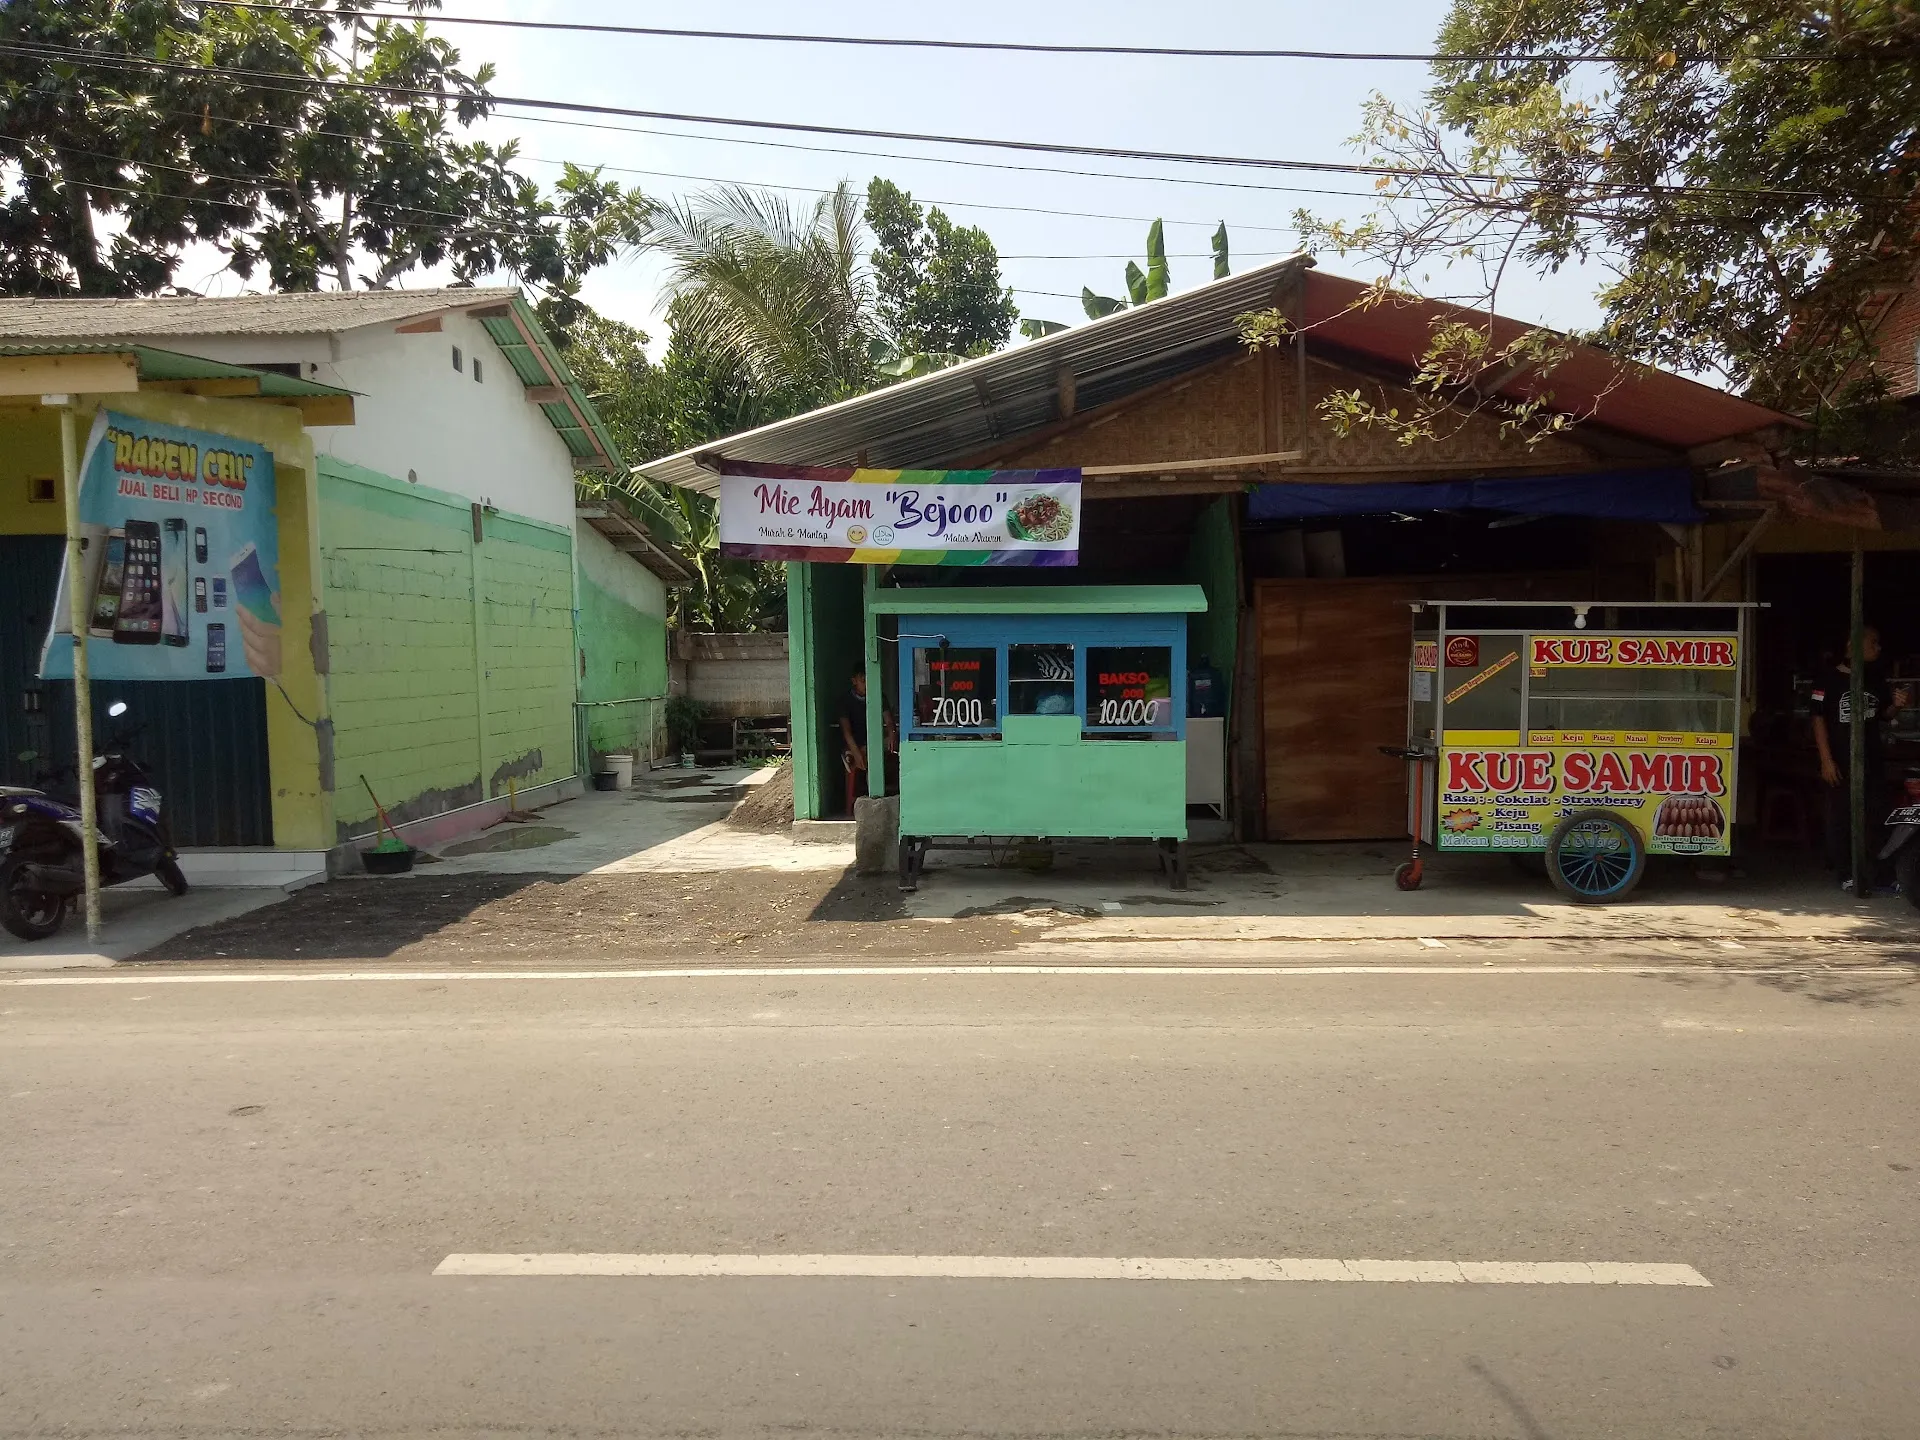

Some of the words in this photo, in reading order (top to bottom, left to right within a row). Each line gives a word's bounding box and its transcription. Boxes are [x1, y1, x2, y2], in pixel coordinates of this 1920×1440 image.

[118, 479, 148, 497] JUAL
[153, 484, 180, 501] BELI
[186, 488, 198, 503] HP
[202, 491, 243, 509] SECOND
[753, 483, 801, 515] Mie
[807, 485, 875, 530] Ayam
[758, 526, 785, 538] Murah
[797, 528, 828, 542] Mantap
[1533, 639, 1613, 664] KUE
[1617, 640, 1735, 667] SAMIR
[951, 661, 980, 671] AYAM
[1098, 672, 1150, 686] BAKSO
[931, 697, 982, 727] 7000
[1098, 698, 1159, 726] 10.000
[1562, 733, 1583, 742] Keju
[1593, 734, 1614, 742] Pisang
[1695, 736, 1717, 745] Kelapa
[1447, 751, 1556, 794] KUE
[1562, 751, 1727, 796] SAMIR
[1562, 795, 1645, 808] Strawberry
[1495, 821, 1542, 833] Pisang
[1442, 834, 1489, 848] Makan
[1493, 834, 1528, 848] Satu
[1652, 835, 1690, 844] Delivery
